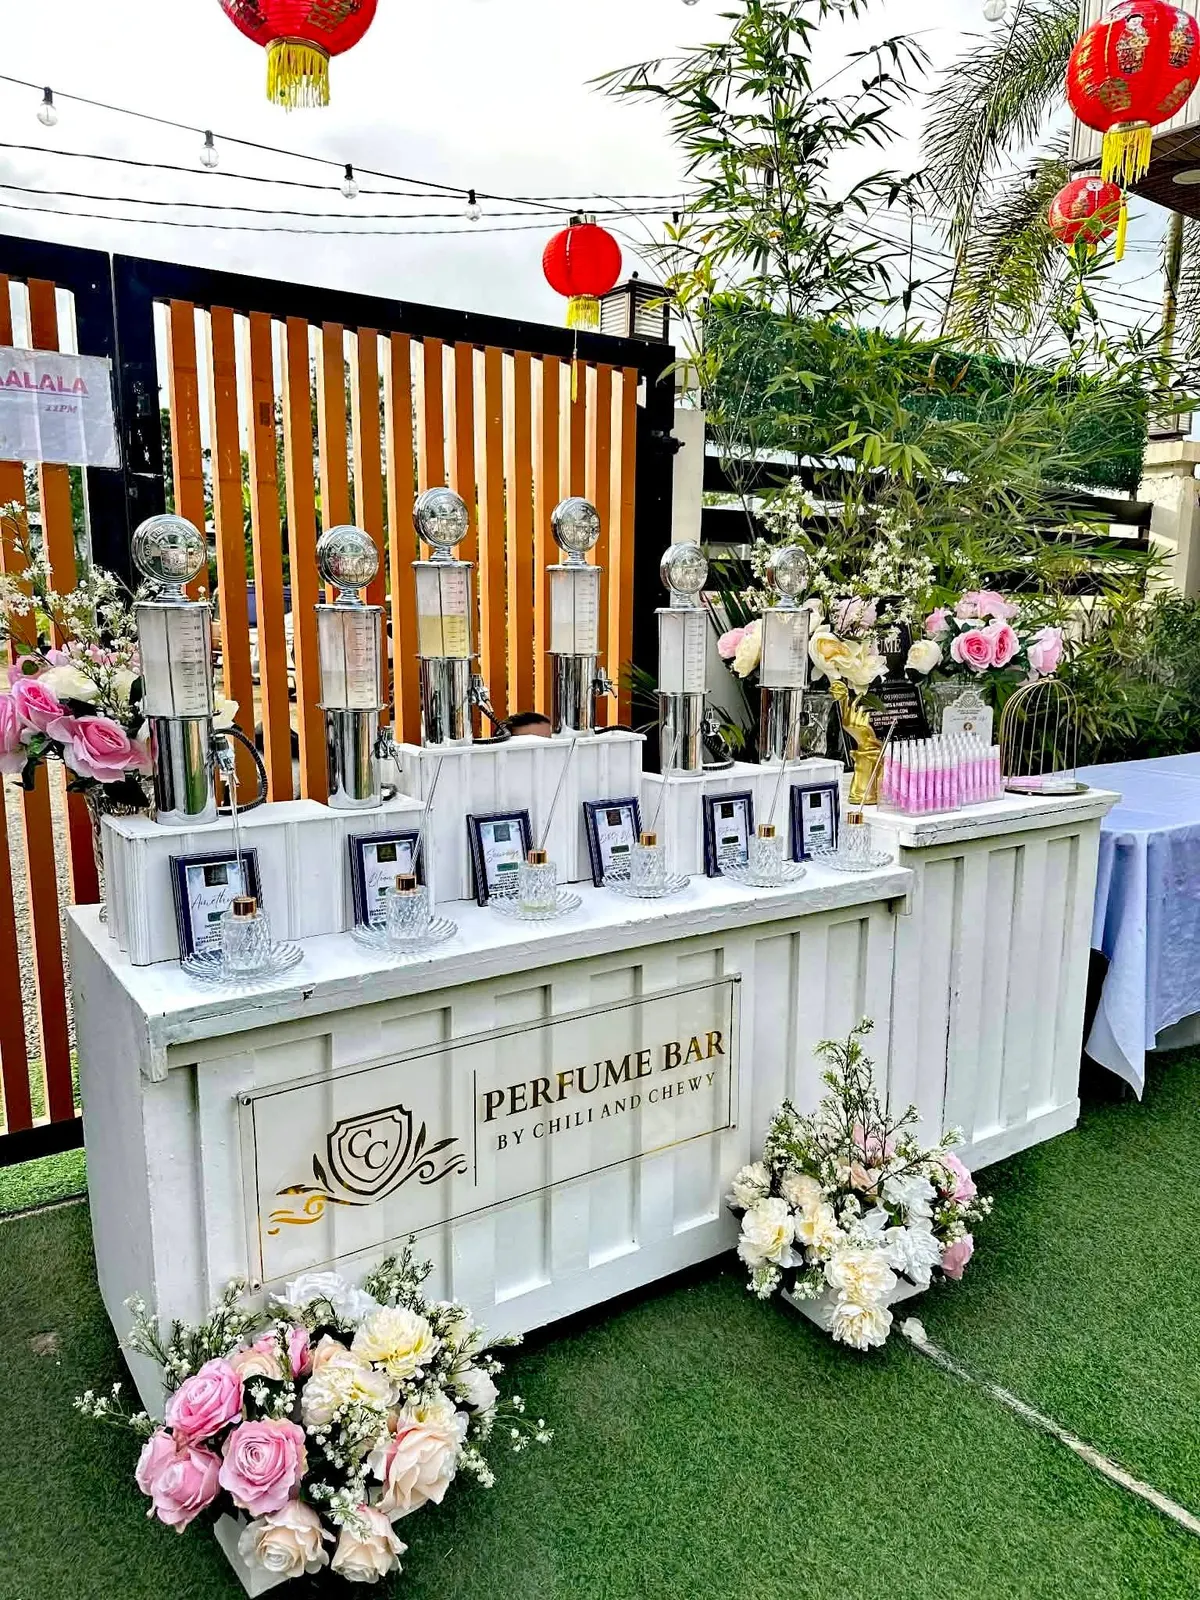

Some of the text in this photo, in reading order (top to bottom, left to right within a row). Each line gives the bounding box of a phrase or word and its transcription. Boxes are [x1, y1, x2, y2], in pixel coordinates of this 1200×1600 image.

[482, 1030, 726, 1123] PERFUME BAR
[496, 1071, 715, 1151] BY CHILI AND CHEWY
